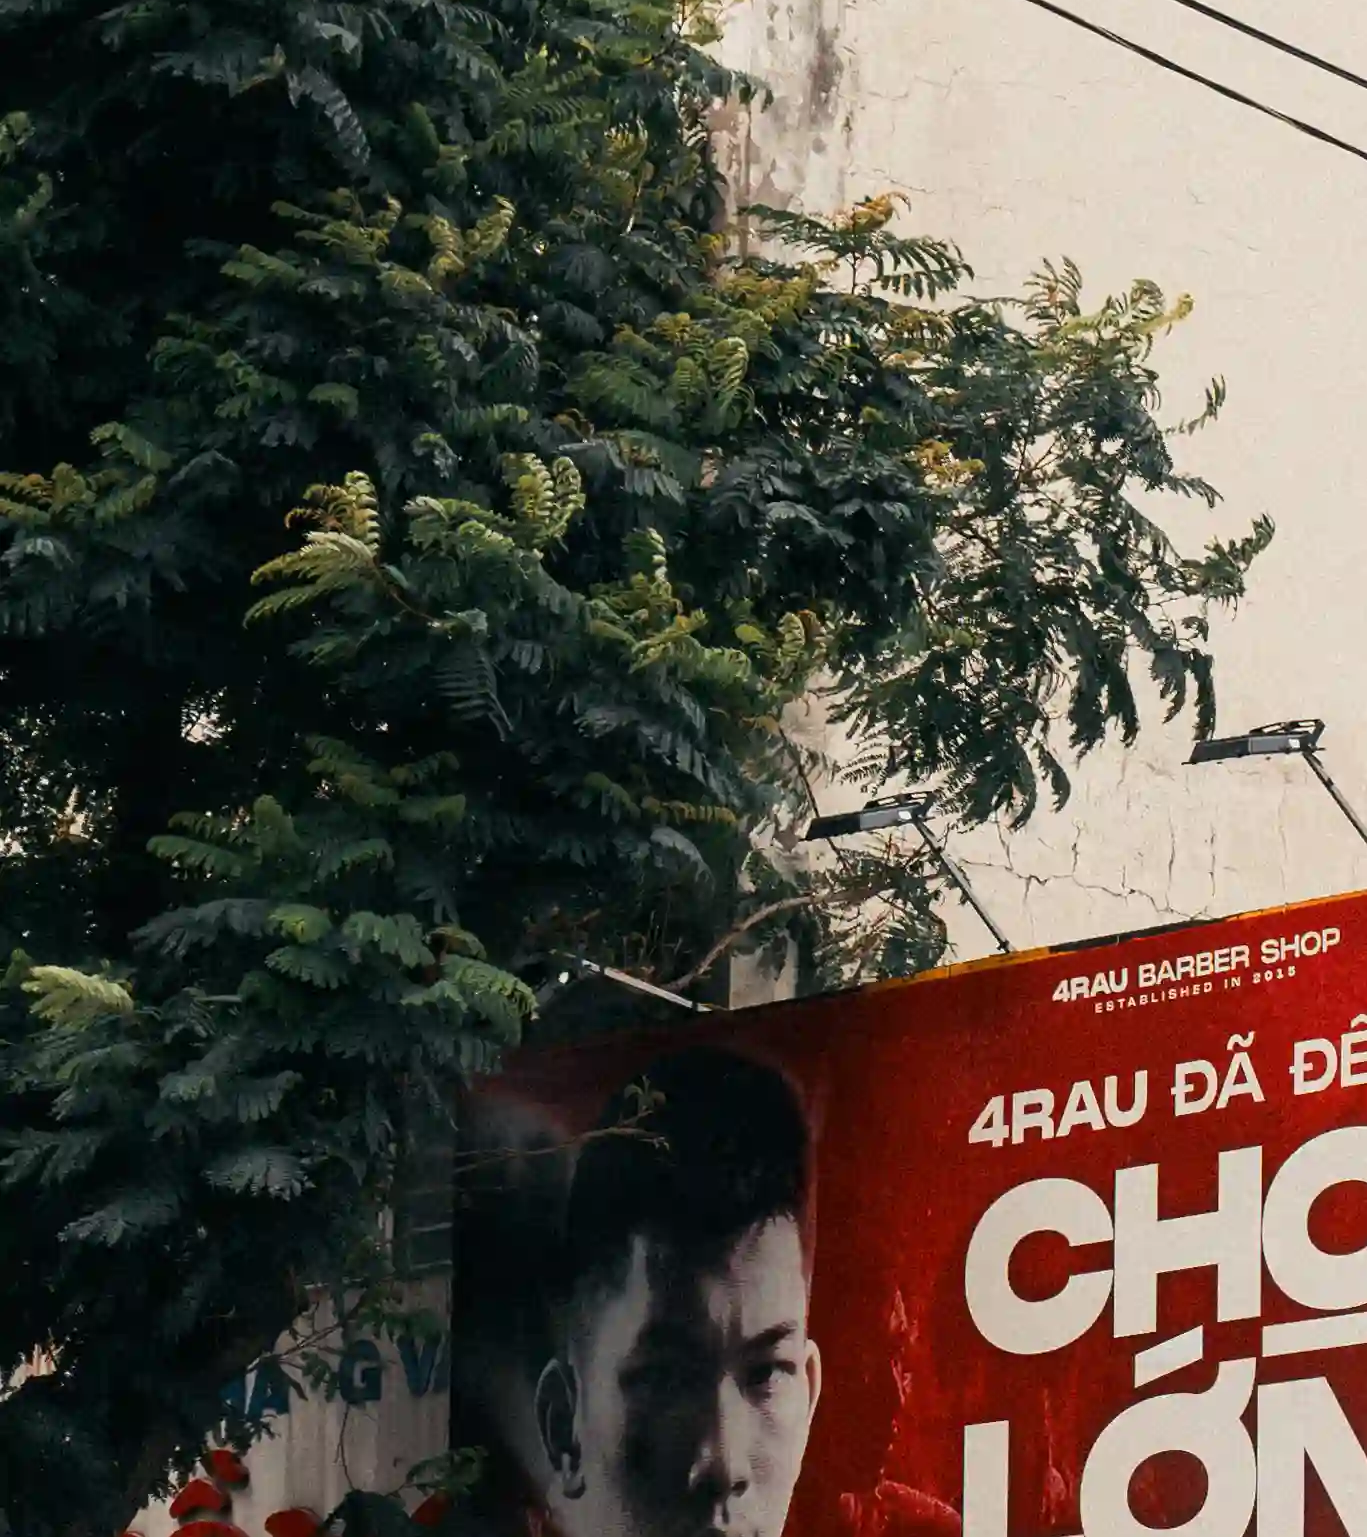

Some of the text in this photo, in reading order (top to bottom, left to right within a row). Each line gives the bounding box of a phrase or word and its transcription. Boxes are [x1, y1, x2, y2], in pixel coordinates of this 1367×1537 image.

[1052, 927, 1341, 1003] 4RAU BARBER SHOP
[1095, 981, 1213, 1014] ESTABLISHED
[1224, 976, 1241, 991] IN
[968, 1069, 1148, 1148] 4RAU
[1172, 1031, 1265, 1117] ĐÃ
